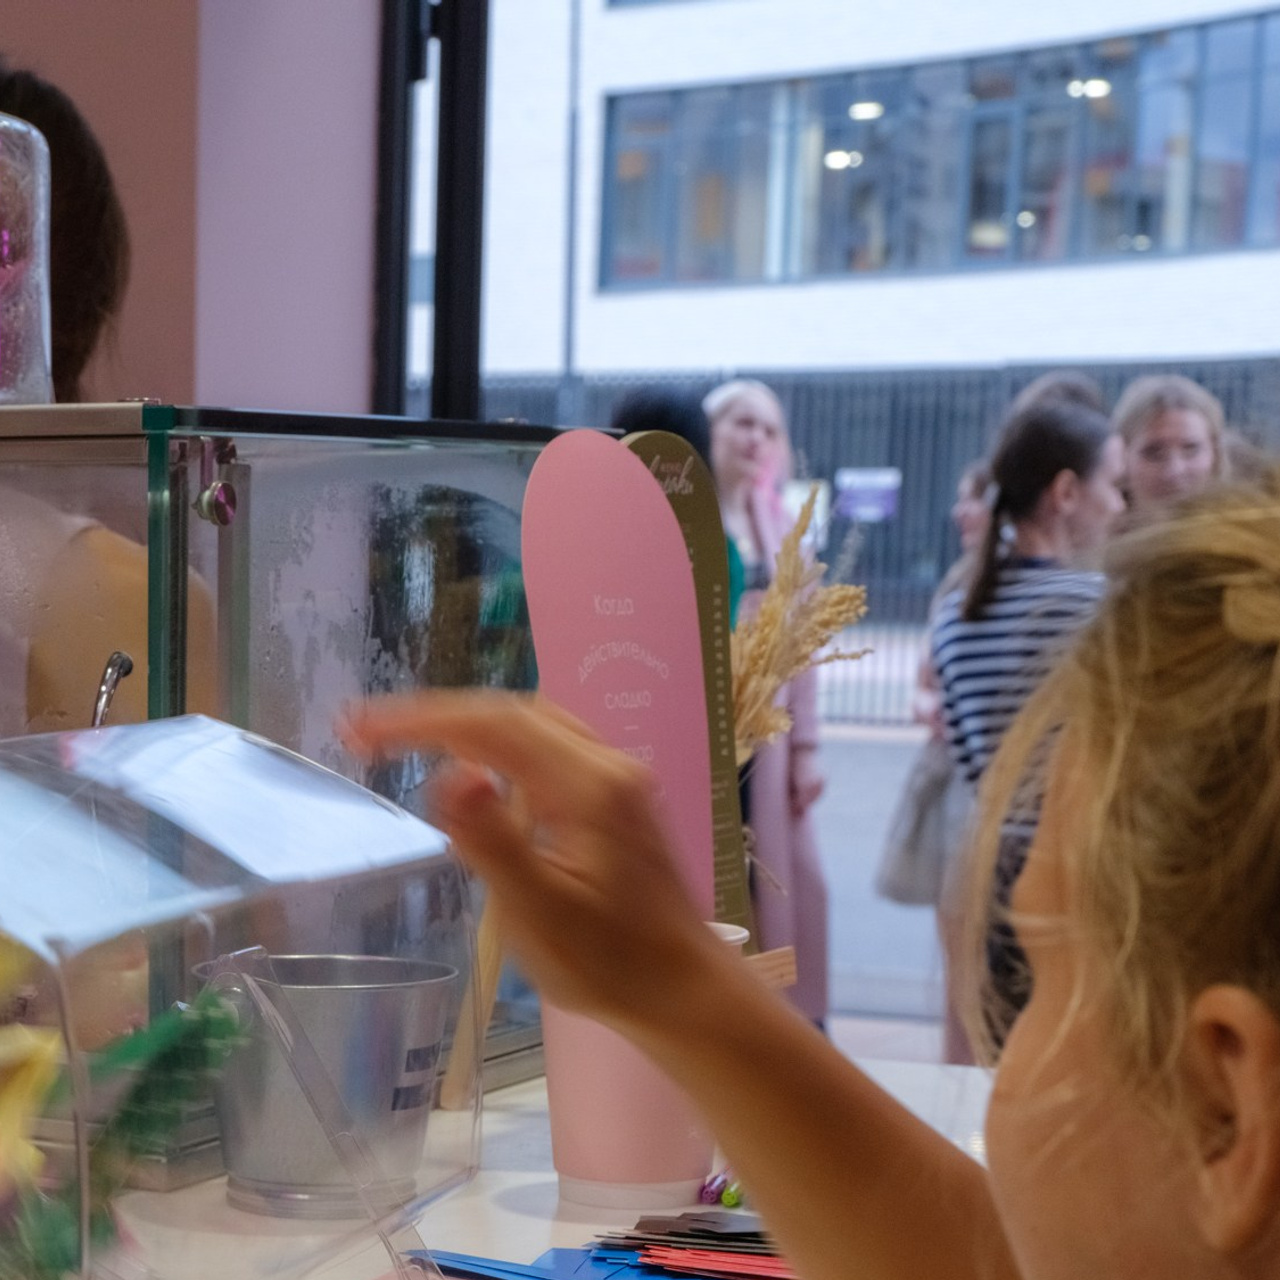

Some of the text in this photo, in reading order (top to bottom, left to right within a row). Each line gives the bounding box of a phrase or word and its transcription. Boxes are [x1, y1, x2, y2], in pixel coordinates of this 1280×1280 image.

[593, 594, 635, 616] Когда
[578, 641, 670, 684] действительно
[605, 690, 652, 710] сладко
